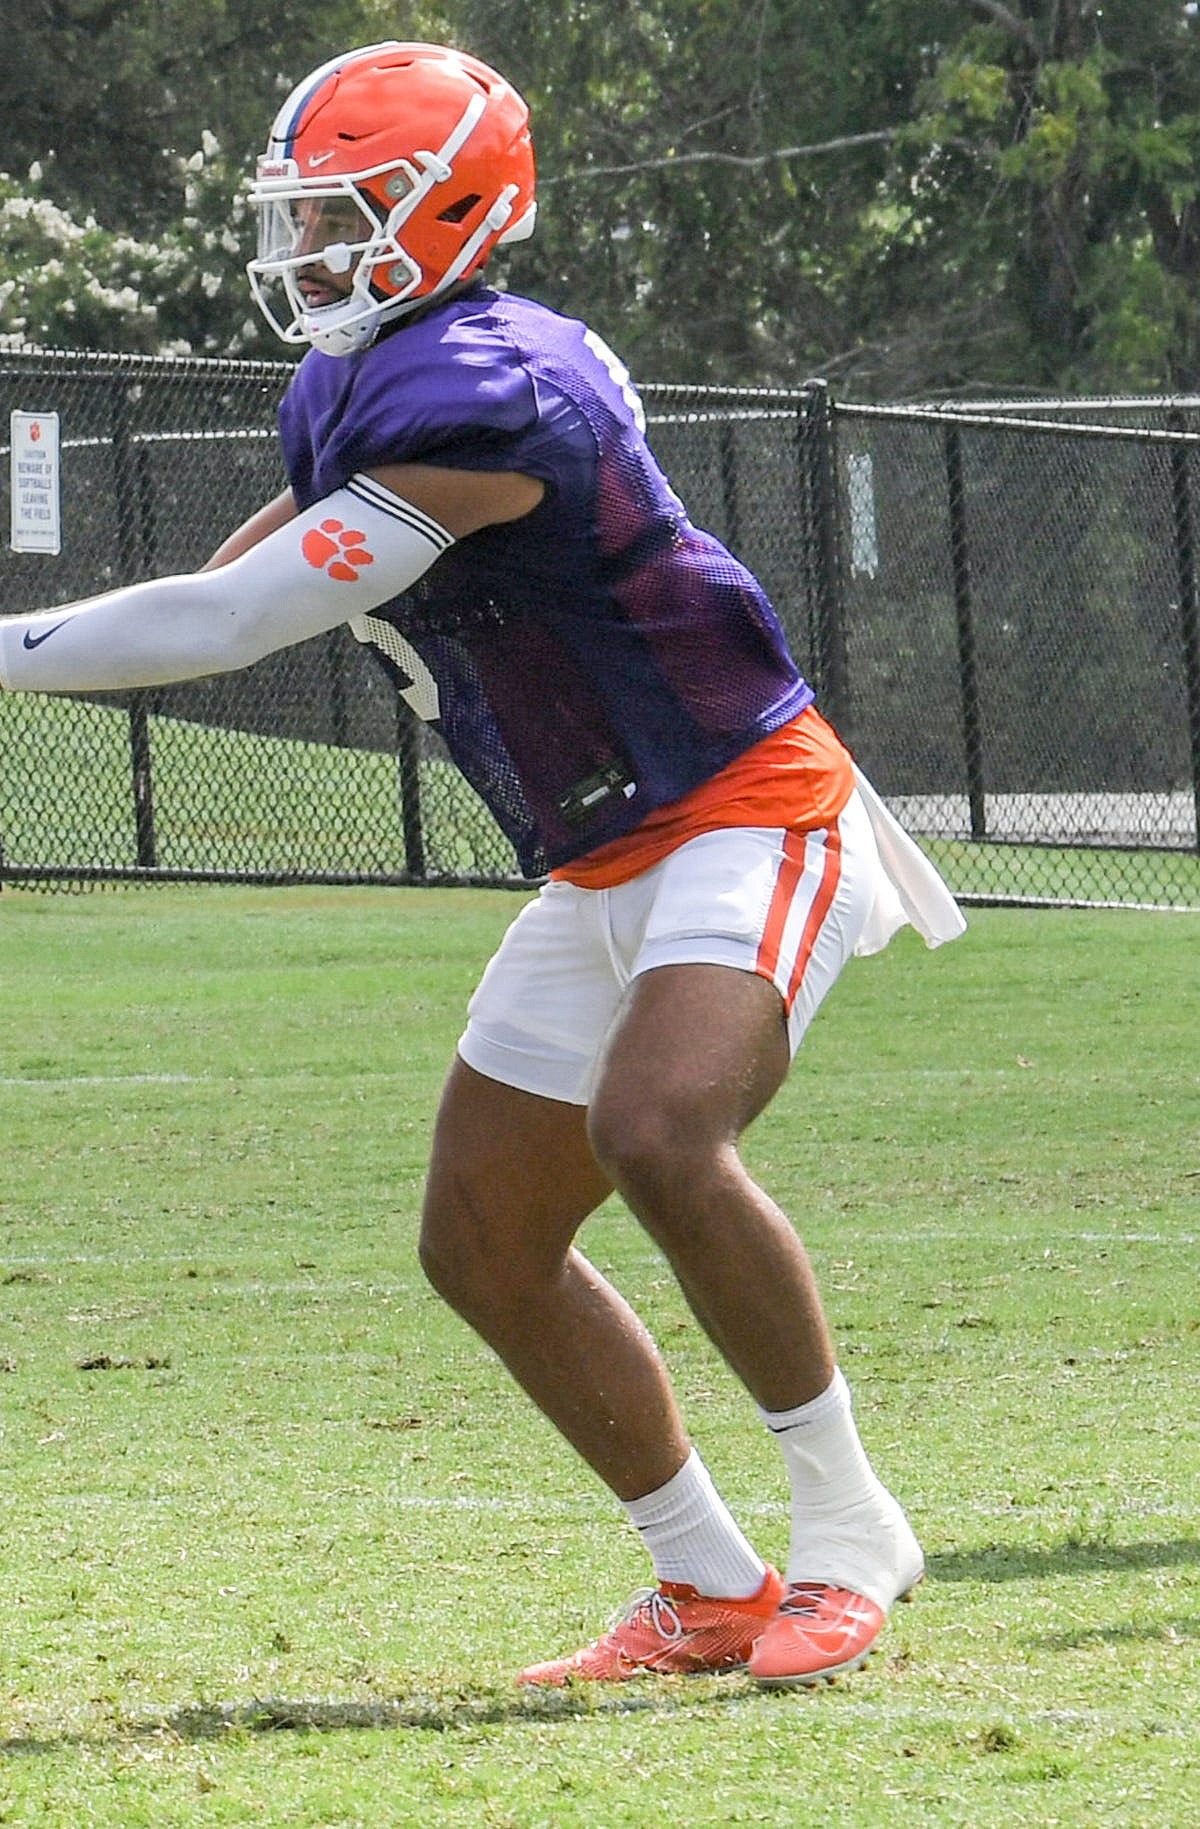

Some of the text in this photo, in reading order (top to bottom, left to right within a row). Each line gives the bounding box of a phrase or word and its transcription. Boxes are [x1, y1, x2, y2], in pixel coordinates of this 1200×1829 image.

[17, 462, 53, 475] BEWARE OF
[18, 478, 52, 489] SOFTBALLS
[23, 493, 49, 505] LEAVING
[20, 507, 51, 520] THE FIELD
